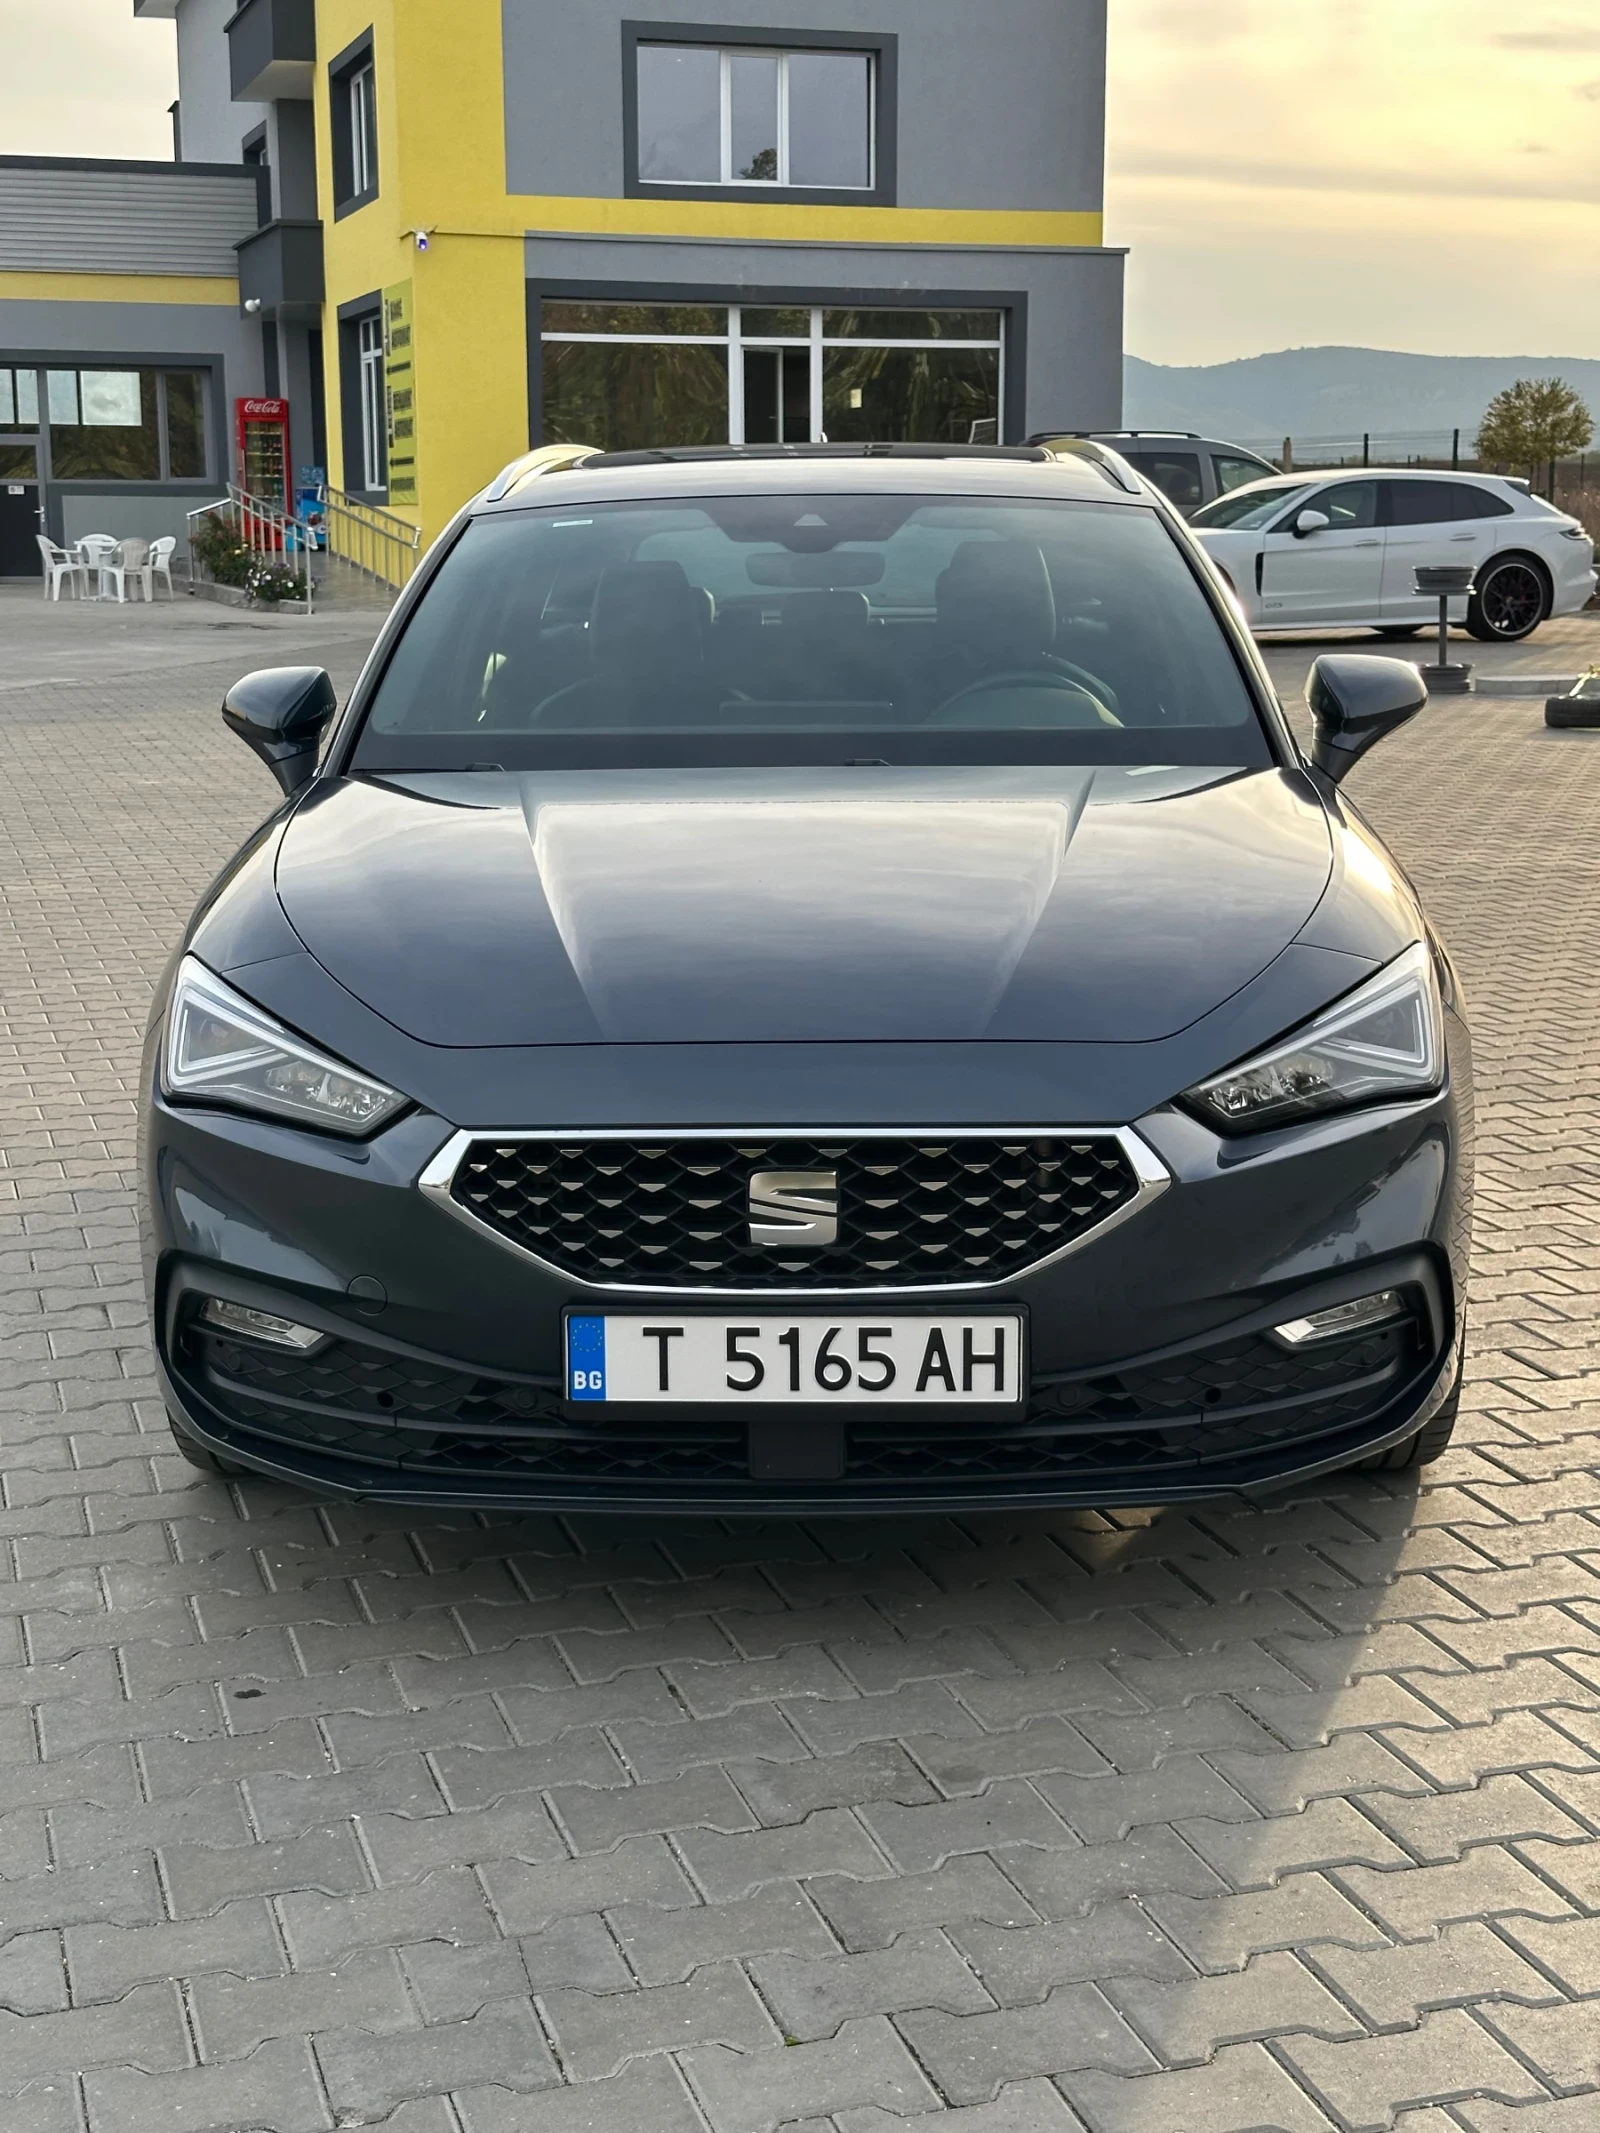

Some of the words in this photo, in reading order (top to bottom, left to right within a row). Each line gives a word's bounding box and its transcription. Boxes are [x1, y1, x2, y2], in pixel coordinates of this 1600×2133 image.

[573, 1370, 602, 1390] BG
[643, 1327, 684, 1391] T
[726, 1327, 897, 1392] 5165
[915, 1327, 1006, 1391] AH
